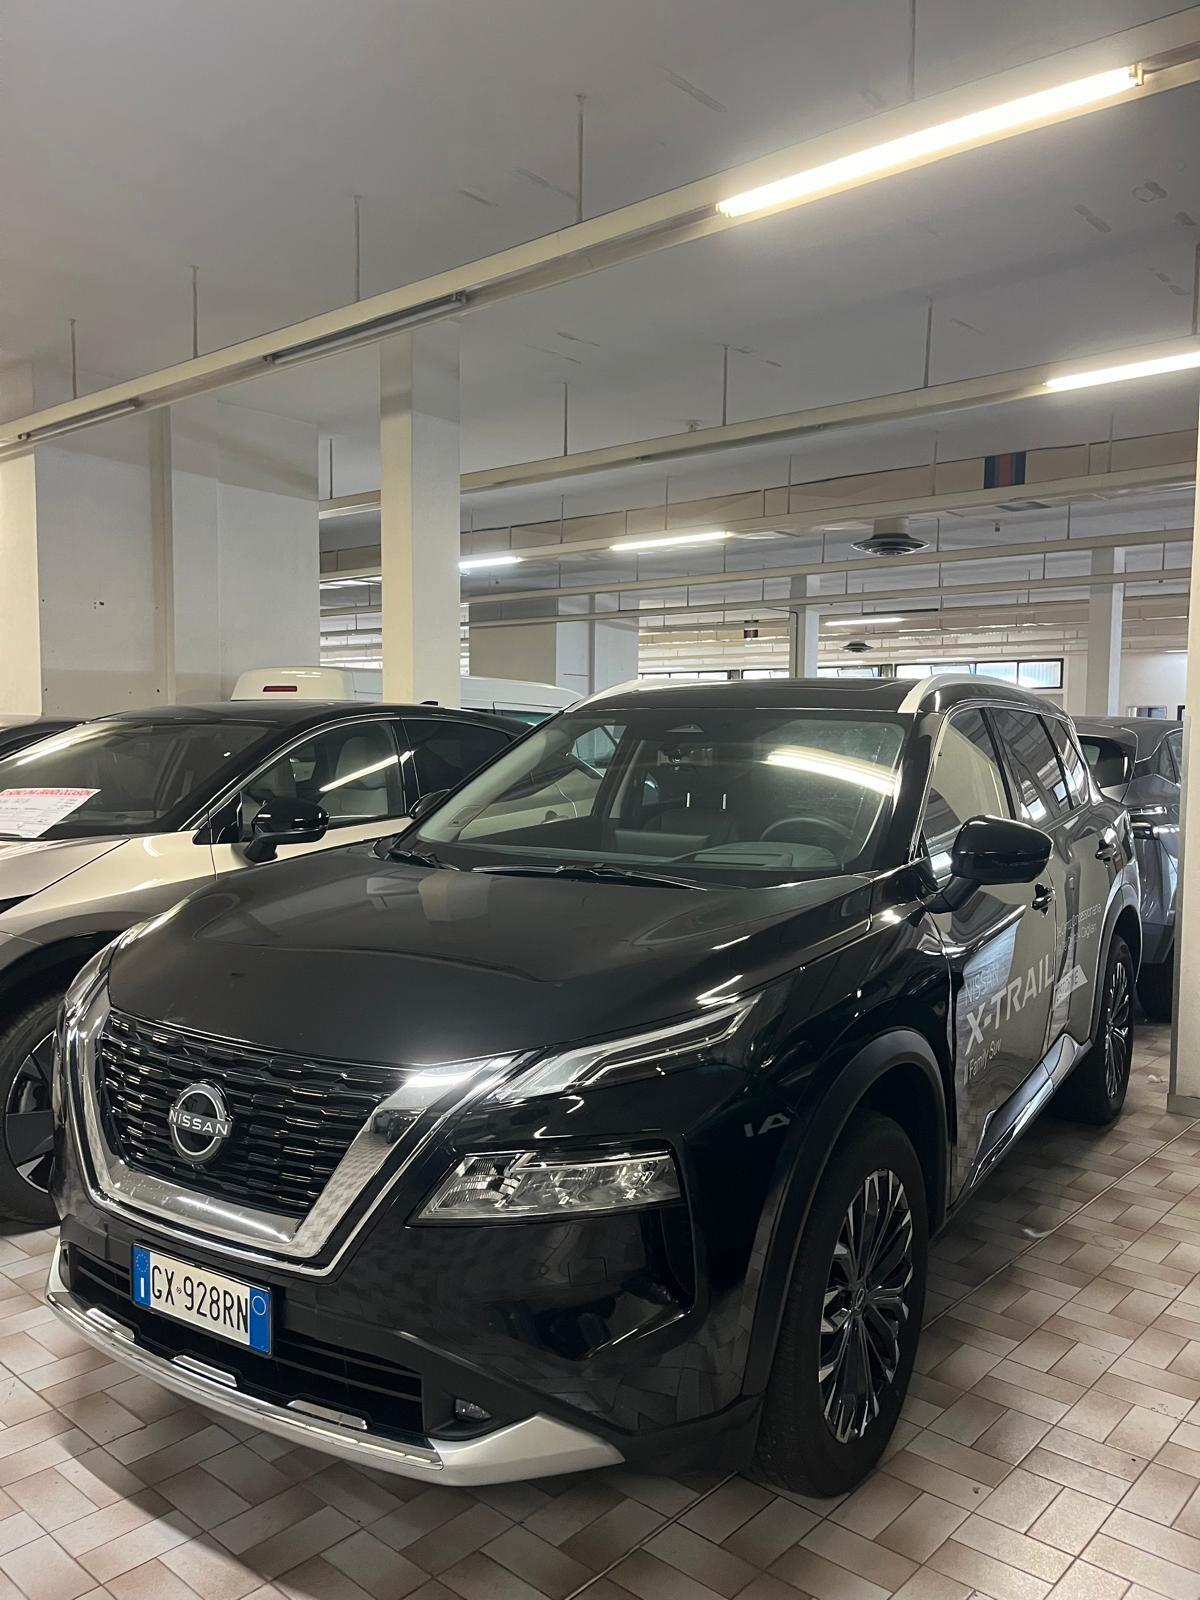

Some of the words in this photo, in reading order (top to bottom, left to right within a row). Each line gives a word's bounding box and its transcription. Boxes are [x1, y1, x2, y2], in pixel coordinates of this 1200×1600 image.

[964, 954, 1055, 1057] X-TRAIL
[965, 960, 1000, 1006] NISSAN
[969, 1046, 989, 1080] Family
[168, 1109, 229, 1136] NISSAN
[152, 1264, 175, 1307] GX
[183, 1276, 249, 1334] 928RN
